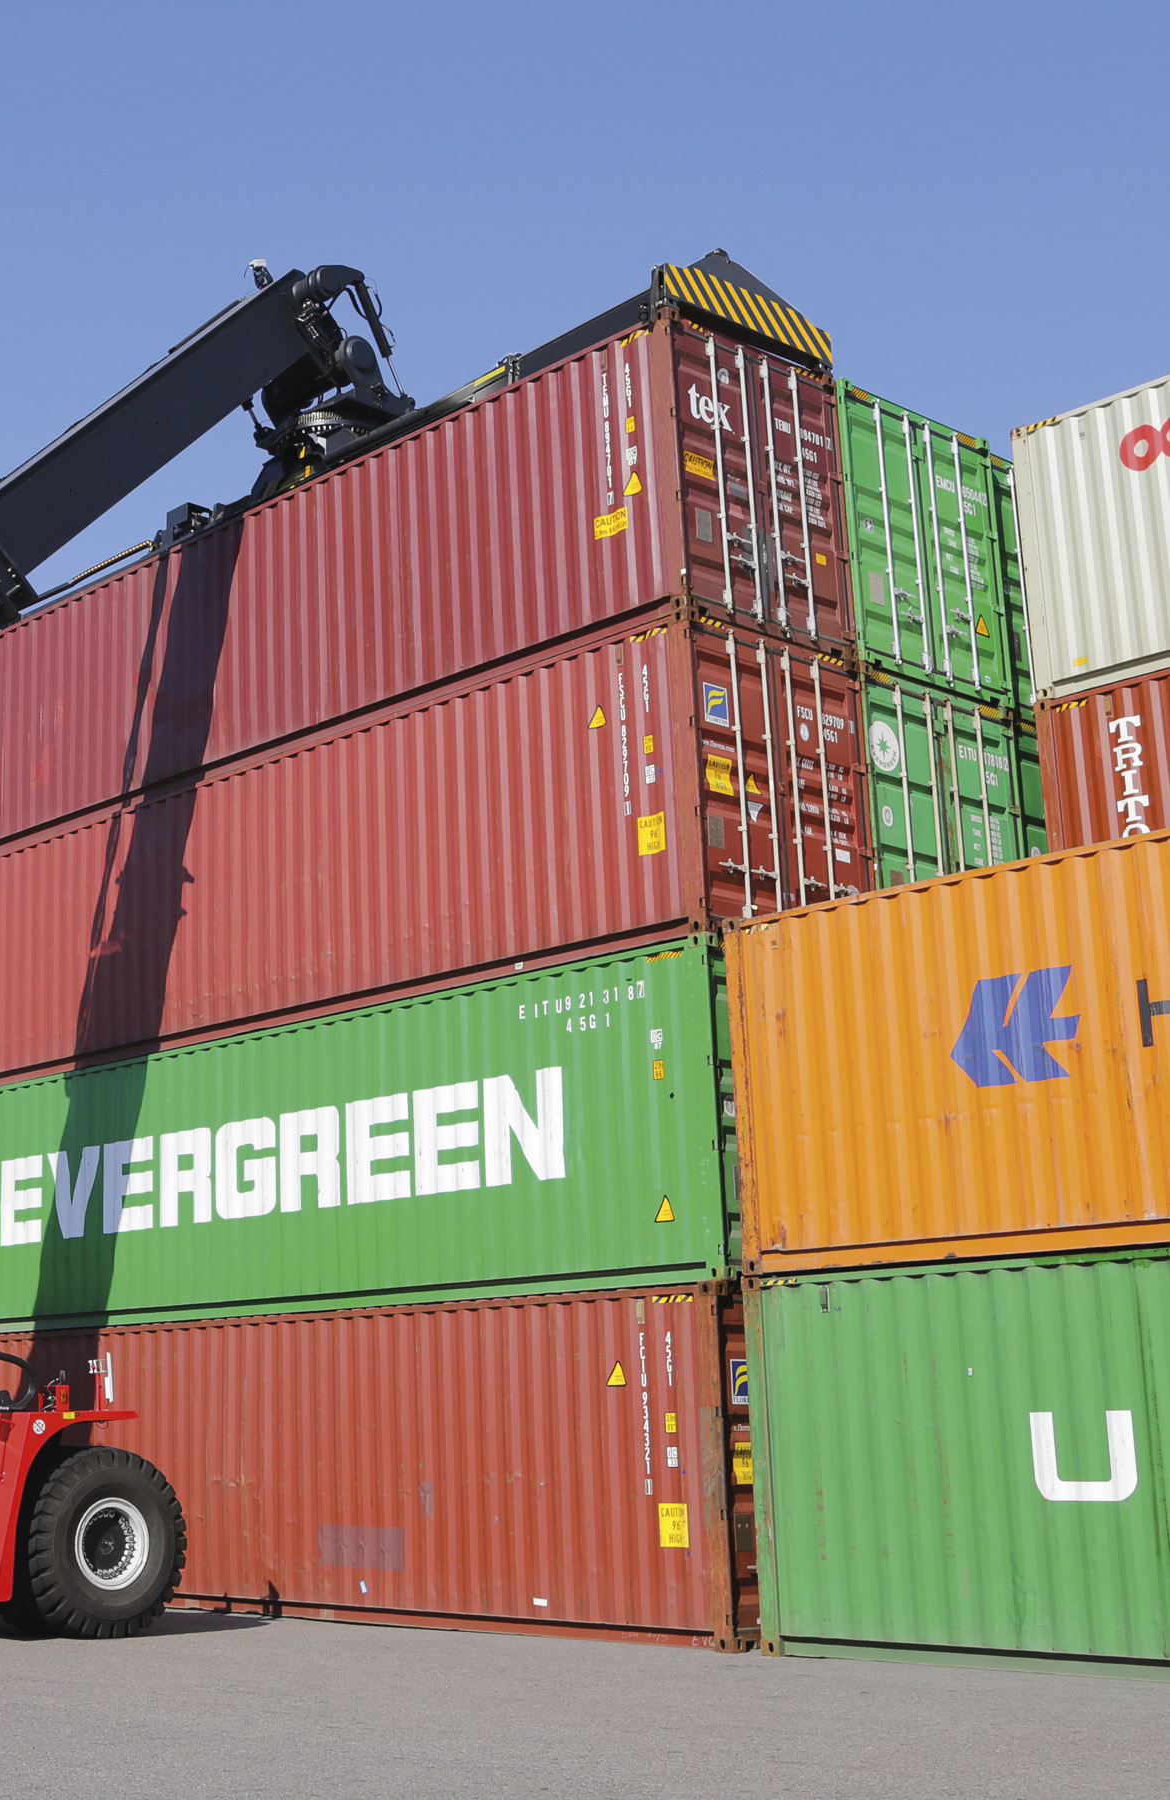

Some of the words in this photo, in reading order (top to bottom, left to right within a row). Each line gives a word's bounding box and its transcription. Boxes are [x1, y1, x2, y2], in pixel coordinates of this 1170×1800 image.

[601, 373, 610, 418] TEMU
[624, 362, 633, 408] 45G1
[688, 383, 733, 432] tex
[774, 418, 792, 434] TEMU
[604, 421, 612, 488] 894701
[684, 451, 714, 472] CAUTION
[934, 475, 956, 494] EMCU
[962, 486, 983, 504] 65044
[963, 501, 977, 517] 5G1
[595, 510, 627, 529] CAUTION
[617, 672, 627, 721] FSCU
[641, 664, 650, 713] 45G1
[796, 705, 814, 721] FSCU
[621, 725, 630, 798] 829709
[958, 745, 978, 762] EITU
[985, 770, 999, 786] 5G1
[566, 1012, 611, 1033] 45G1
[0, 1065, 567, 1247] EVERGREEN
[639, 1331, 648, 1388] FCIU
[664, 1330, 673, 1387] 45G1
[641, 1391, 651, 1475] 934321
